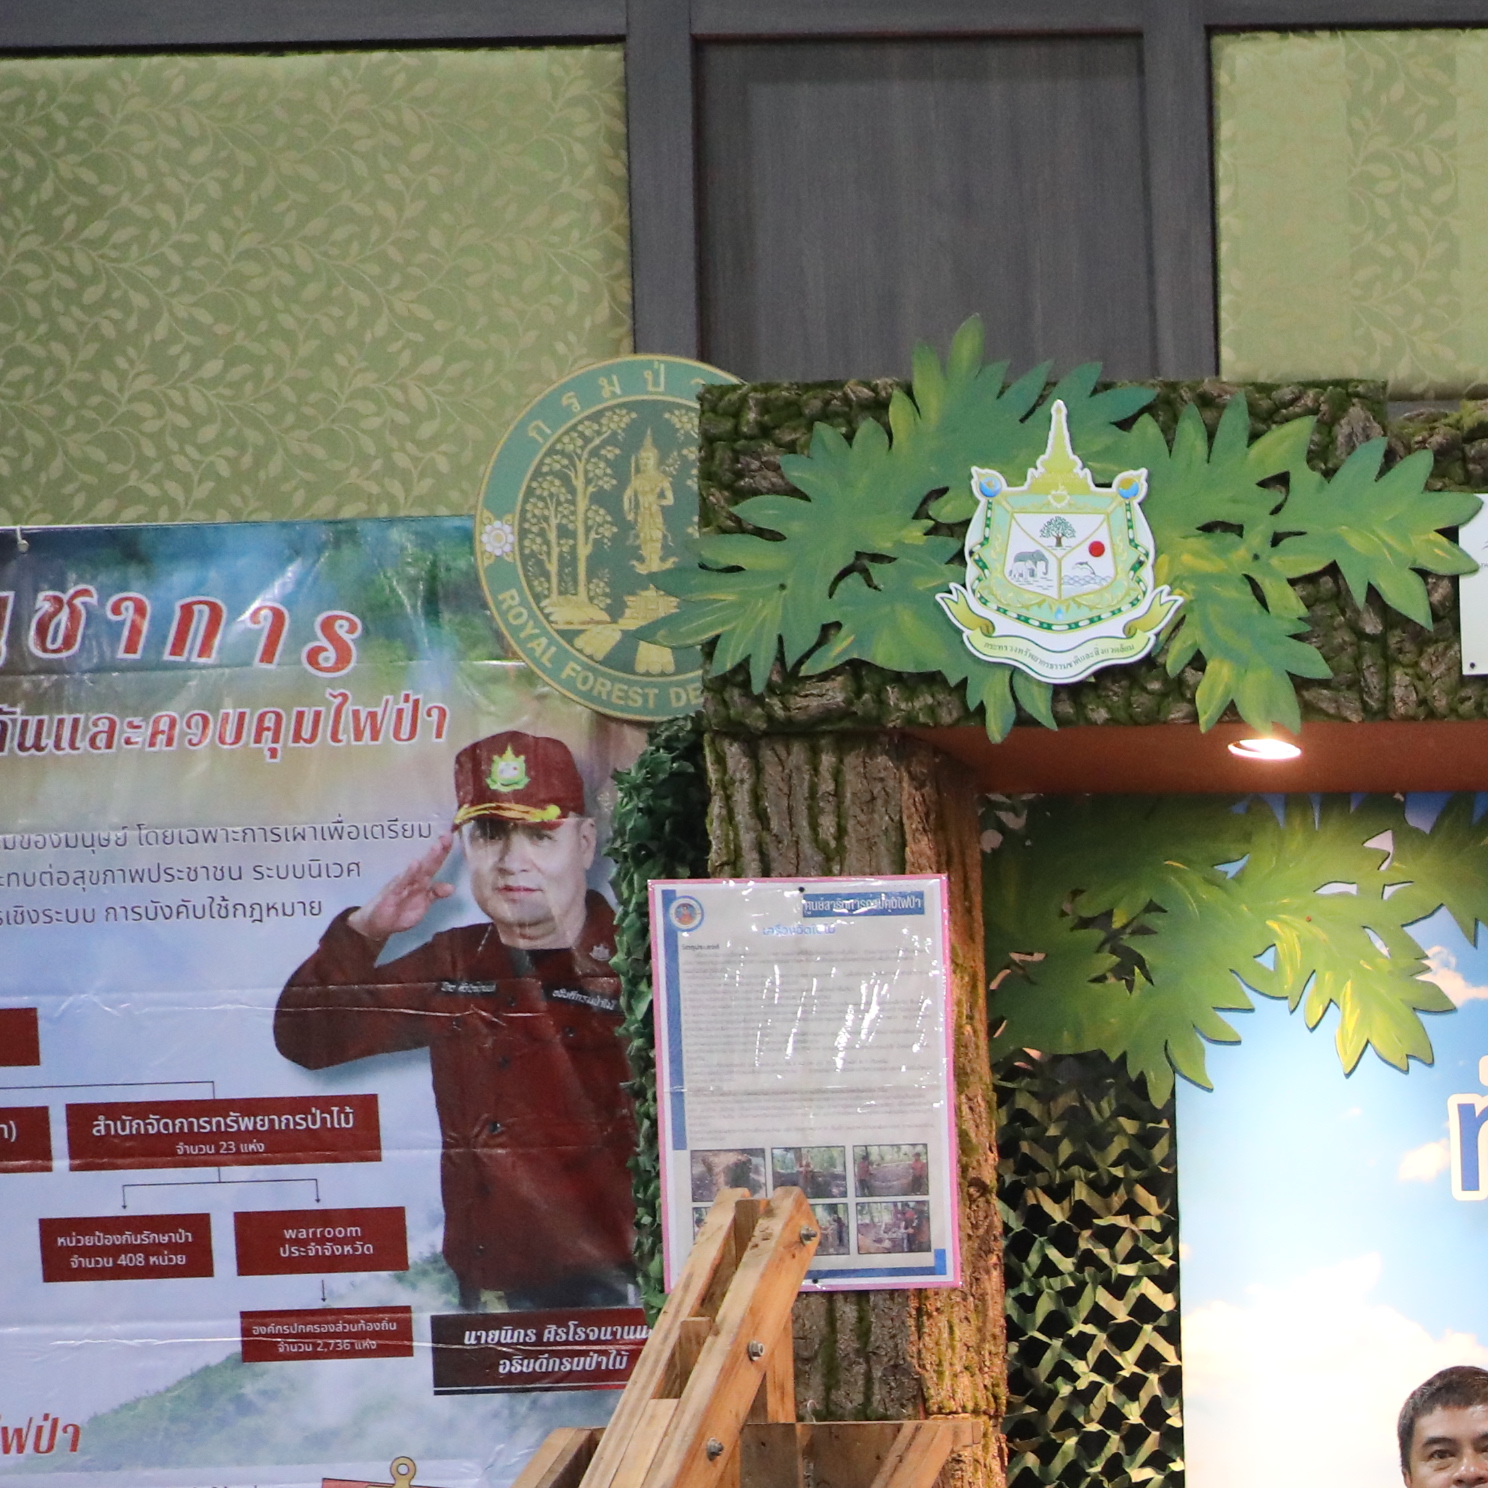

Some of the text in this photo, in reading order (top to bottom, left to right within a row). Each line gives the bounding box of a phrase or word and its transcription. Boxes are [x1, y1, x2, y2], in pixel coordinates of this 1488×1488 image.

[497, 588, 561, 668] ROYAL
[561, 662, 660, 709] FOREST
[136, 814, 431, 847] โดยเฉพาะการเผาเพื่อเตรียม
[252, 859, 361, 884] ระบบนิเวศ
[104, 895, 323, 926] การบังคับใช้กฎหมาย
[92, 1107, 355, 1137] สำนักจัดการทรัพยากรป่าไม้
[176, 1139, 265, 1156] จำนวน 23 แห่ง
[57, 1228, 194, 1248] หน่วยป้องกันรักษาป่า
[283, 1224, 362, 1239] warroom
[70, 1252, 187, 1269] จำนวน 408 หน่วย
[279, 1240, 375, 1259] ประจำจังหวัด
[464, 1320, 654, 1345] นายนิกร ศิรโรจนานน
[498, 1349, 629, 1374] อธิบดีกรมป่าไม้
[0, 1413, 82, 1455] ฟป่า
